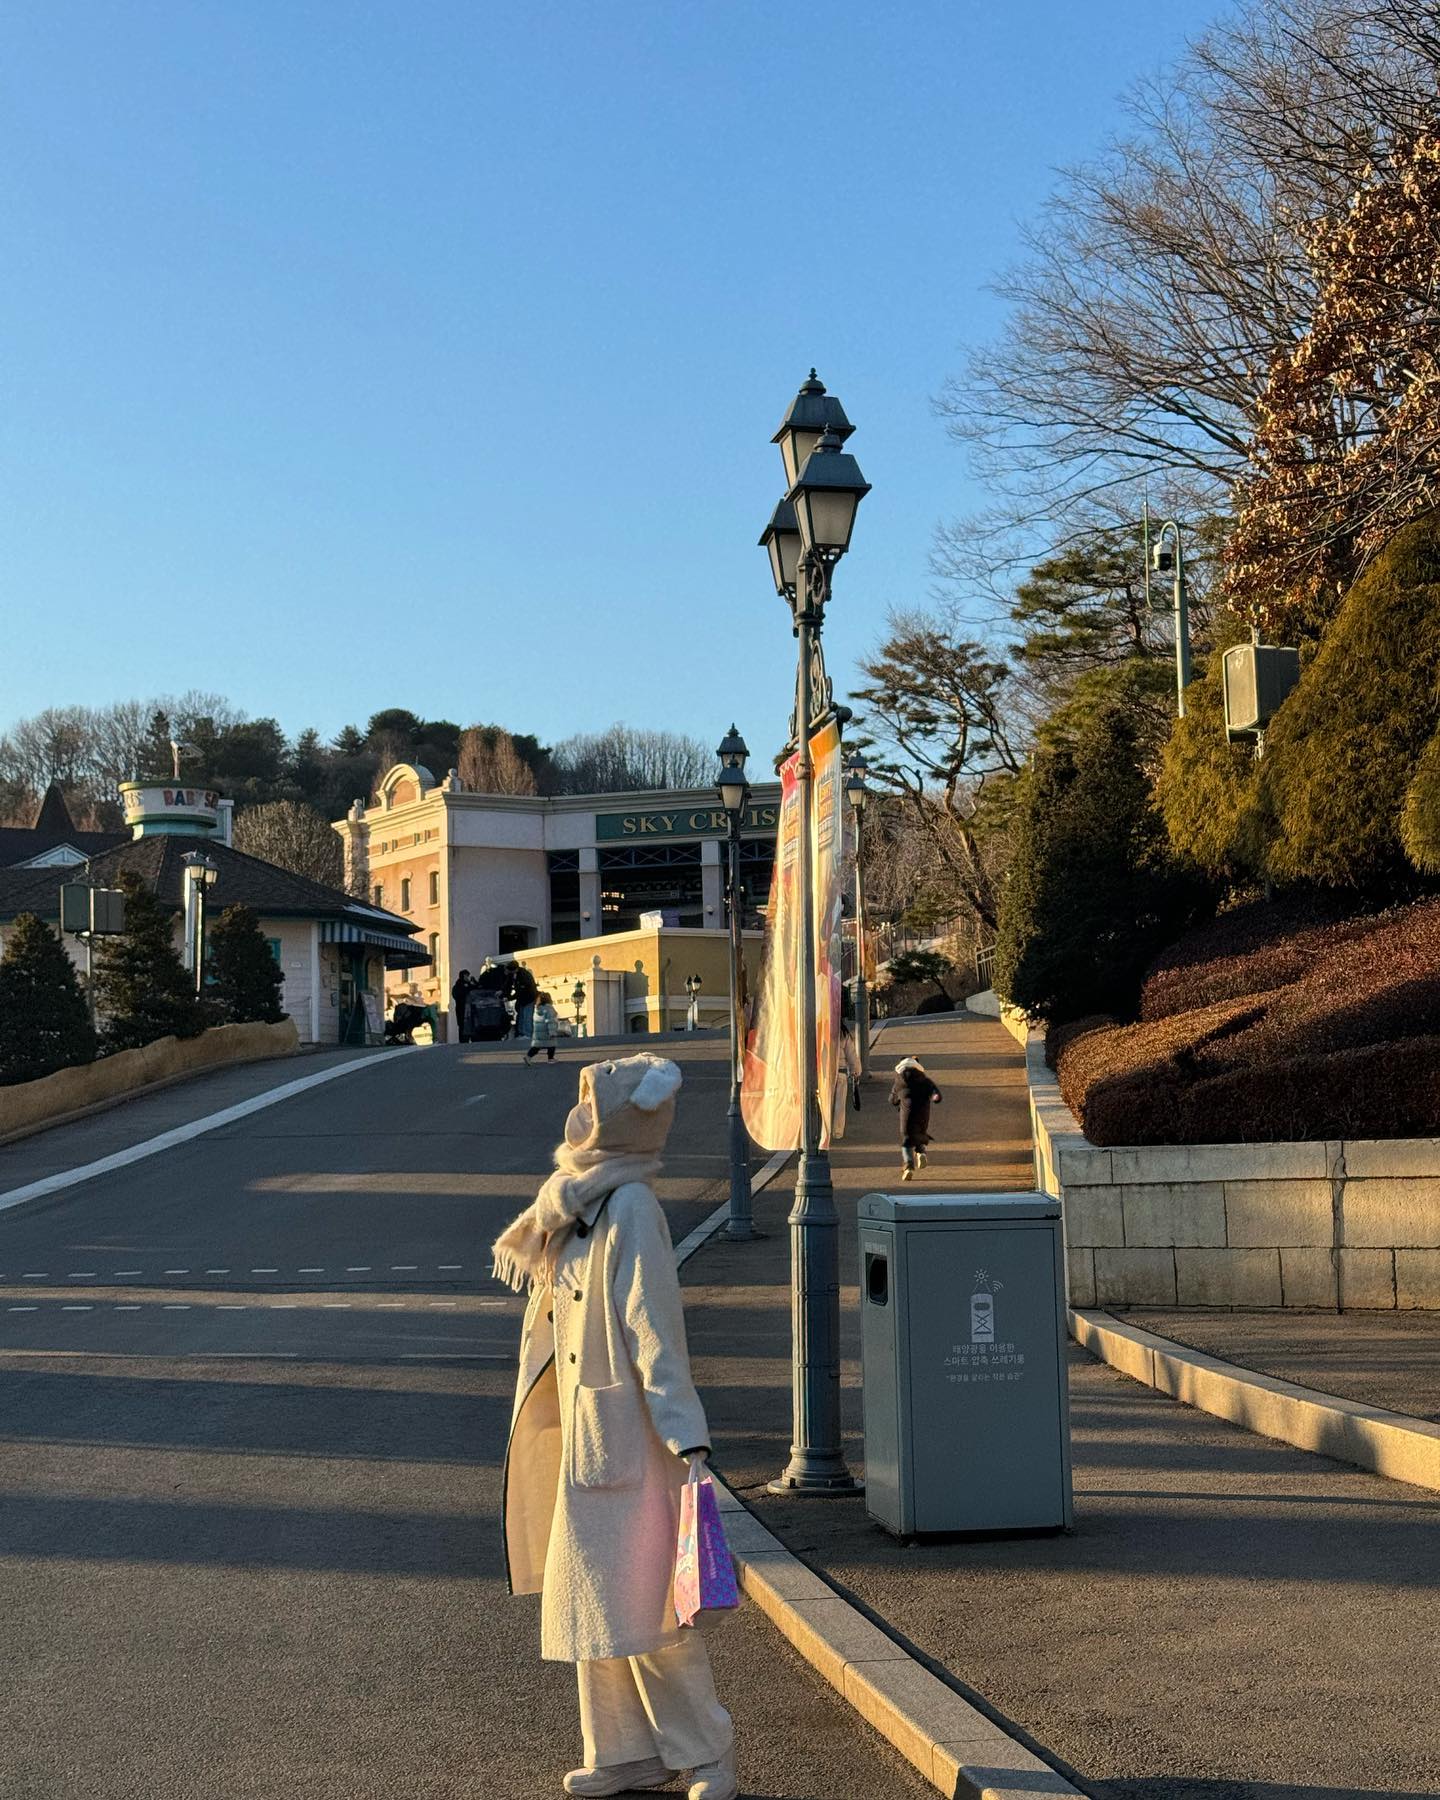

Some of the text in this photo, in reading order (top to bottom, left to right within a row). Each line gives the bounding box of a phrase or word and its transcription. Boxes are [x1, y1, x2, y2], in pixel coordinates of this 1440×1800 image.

[623, 808, 776, 834] SKY CRIS
[944, 1356, 969, 1366] 스마트
